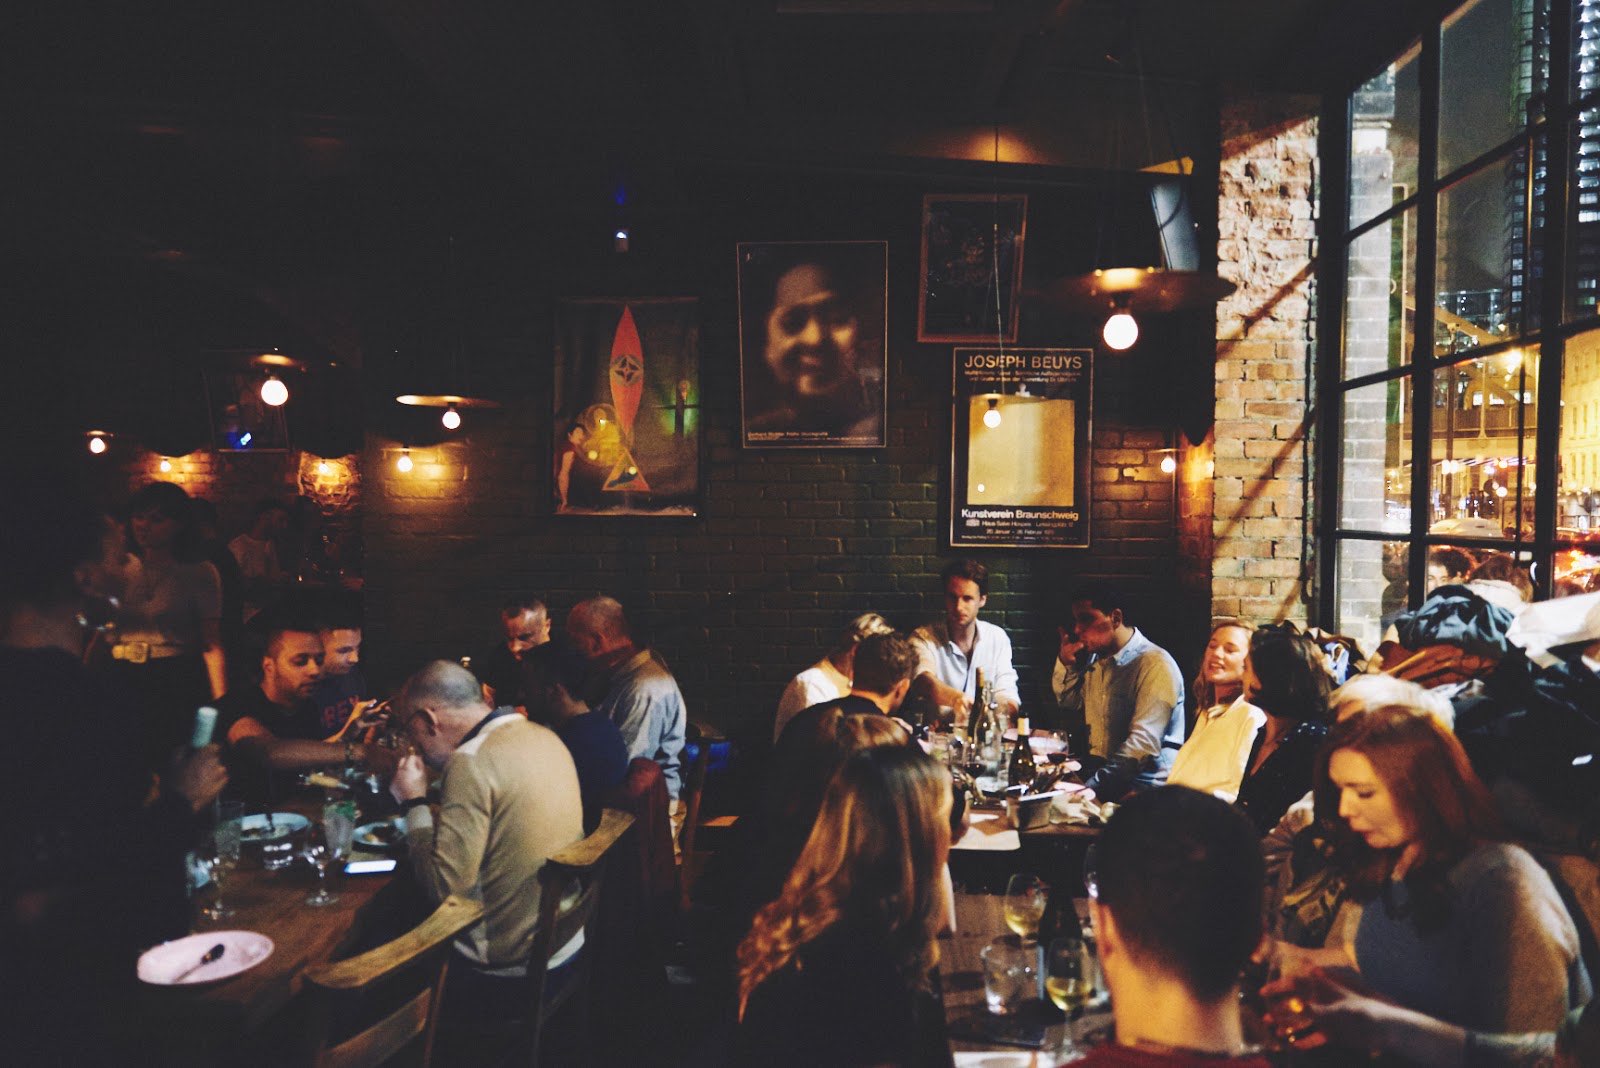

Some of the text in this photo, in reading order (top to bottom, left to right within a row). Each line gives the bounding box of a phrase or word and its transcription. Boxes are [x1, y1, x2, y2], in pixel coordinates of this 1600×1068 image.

[964, 355, 1082, 369] JOSEPH BEUYS
[961, 509, 1079, 521] Kunstverein Braunschweig
